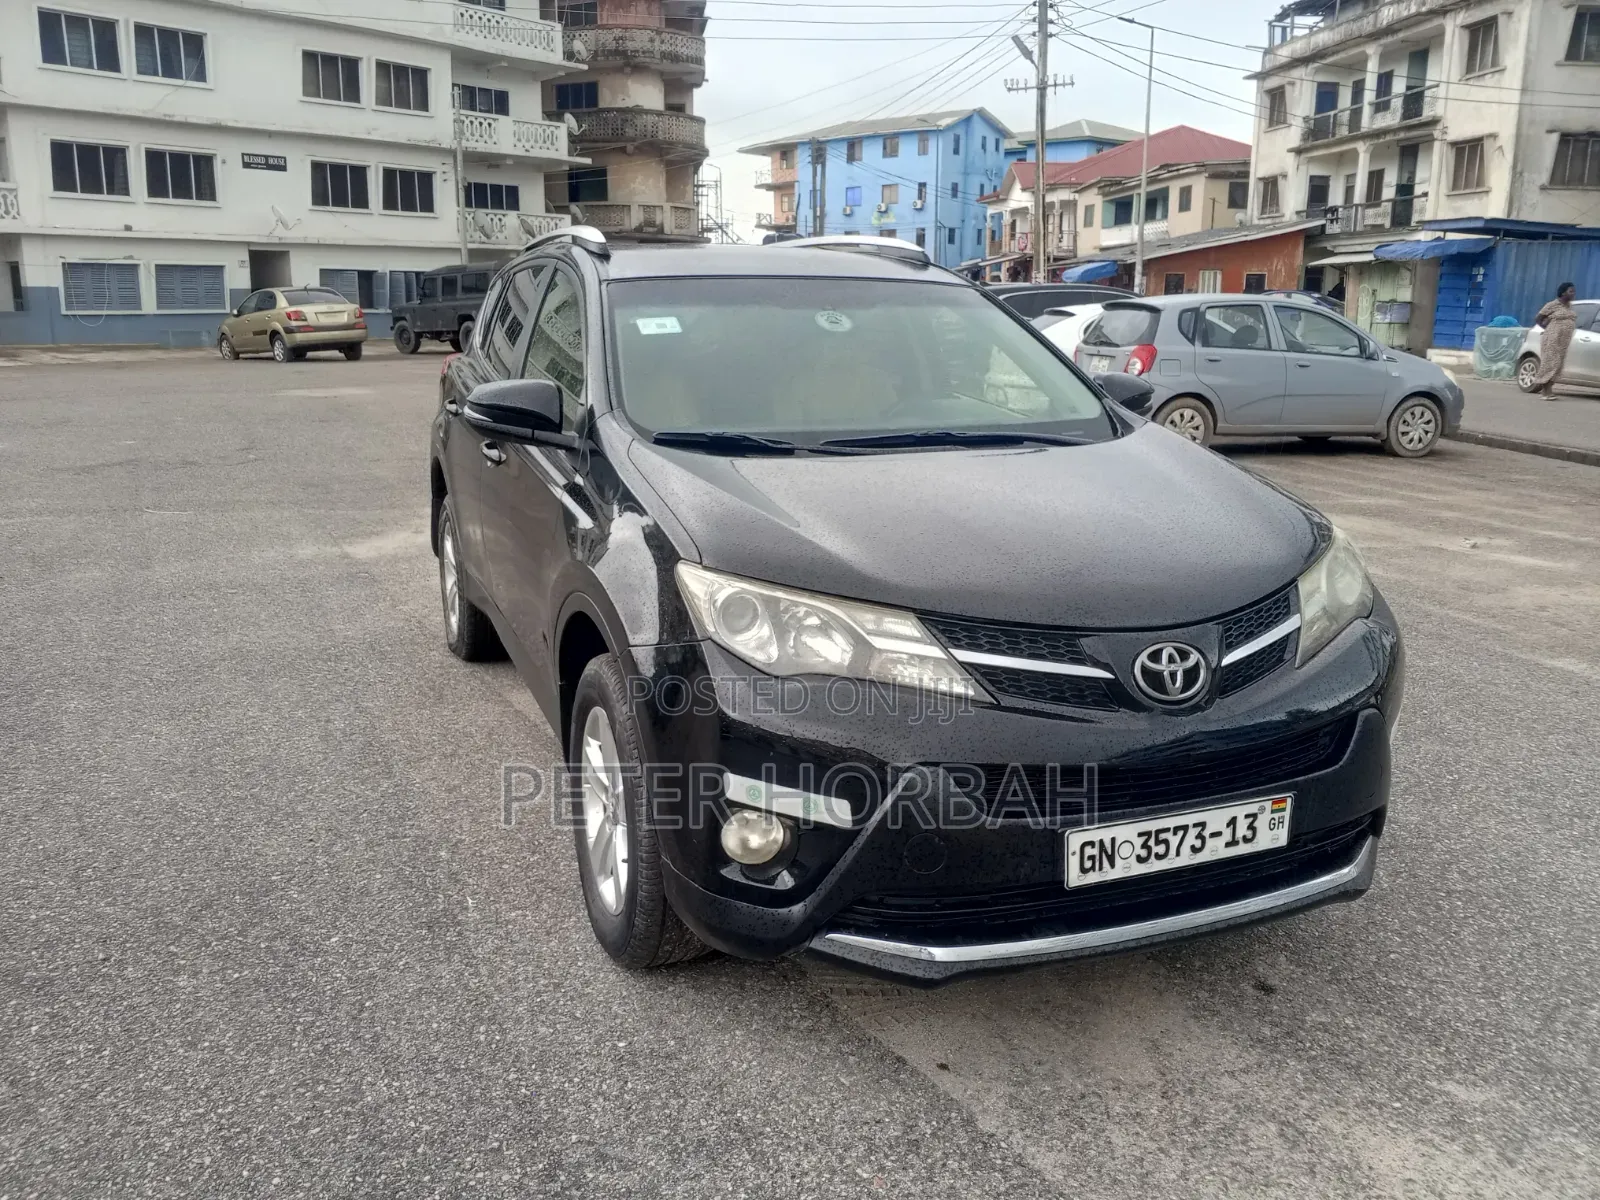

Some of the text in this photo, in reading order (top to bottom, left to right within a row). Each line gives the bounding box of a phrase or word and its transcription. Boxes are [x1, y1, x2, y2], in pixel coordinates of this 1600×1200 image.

[267, 156, 285, 166] HOUSE
[1268, 816, 1285, 832] GH
[1078, 812, 1259, 875] GN 3573-13
